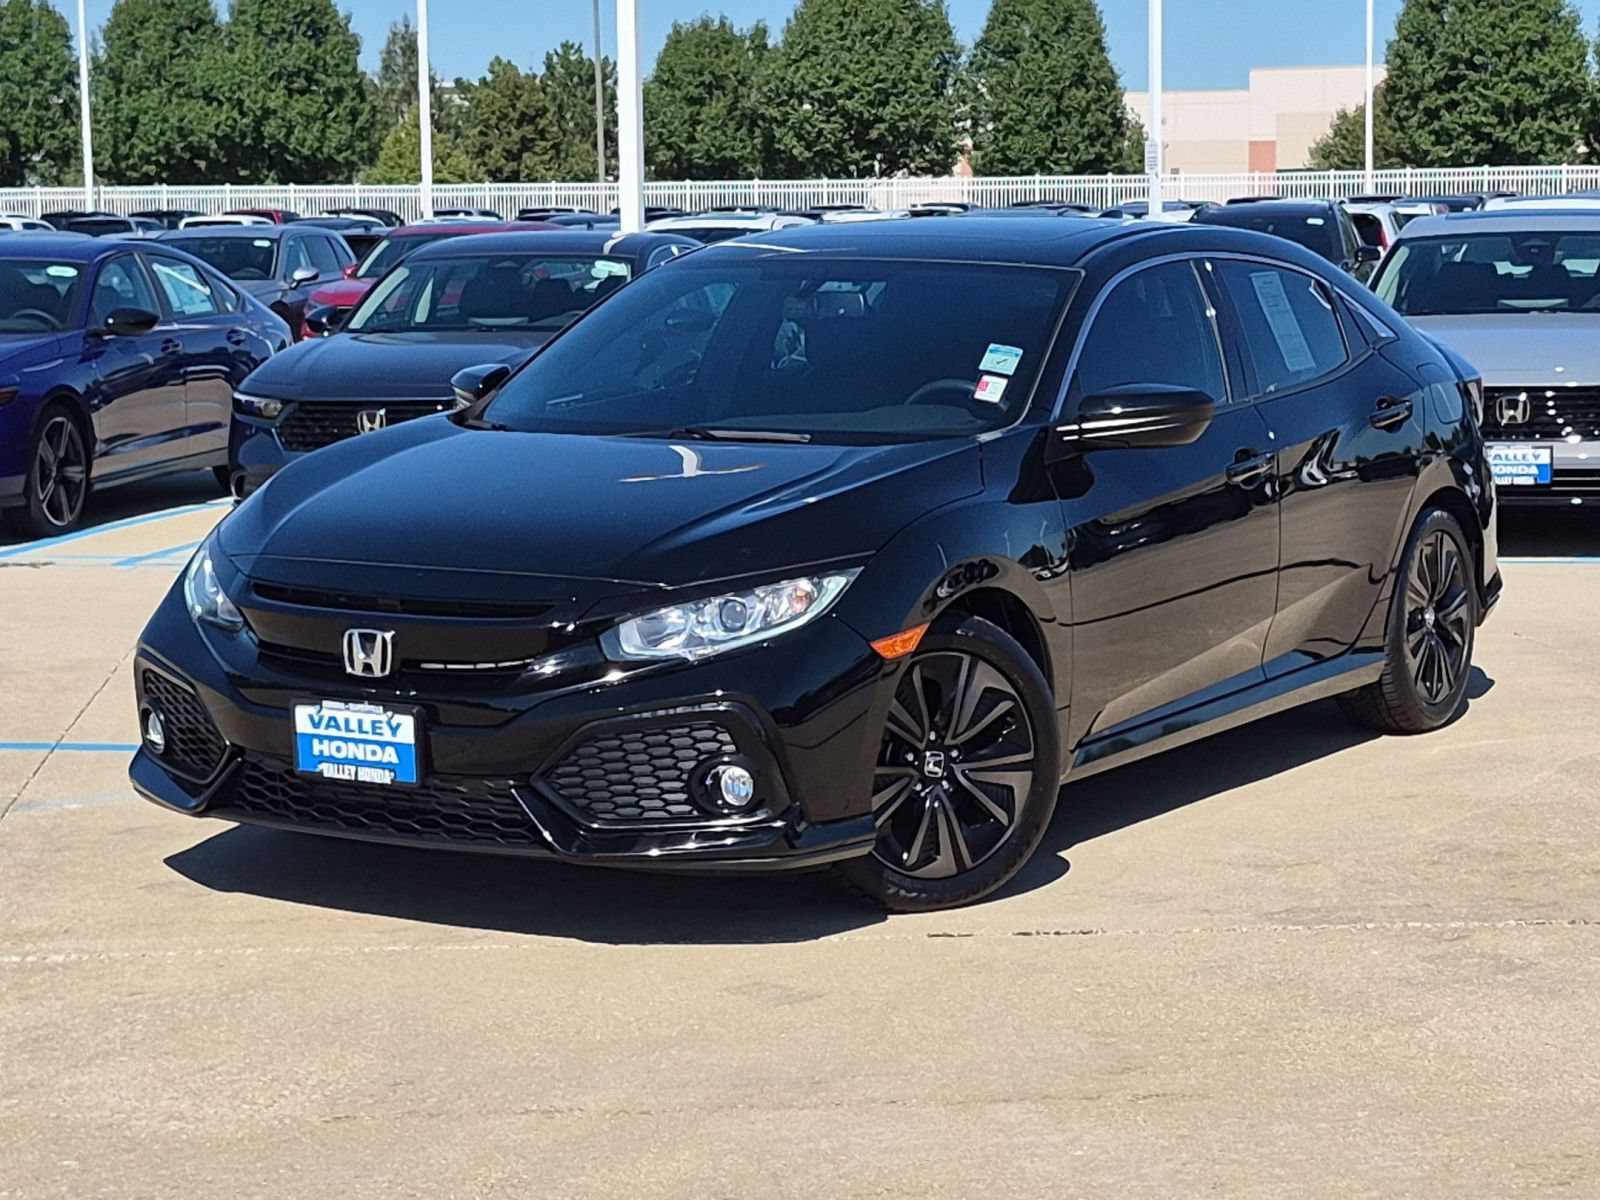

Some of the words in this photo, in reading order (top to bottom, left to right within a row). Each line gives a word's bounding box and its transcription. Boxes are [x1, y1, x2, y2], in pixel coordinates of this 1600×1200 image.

[1491, 464, 1540, 475] ONDA
[307, 713, 403, 738] VALLEY
[311, 738, 400, 764] HONDA
